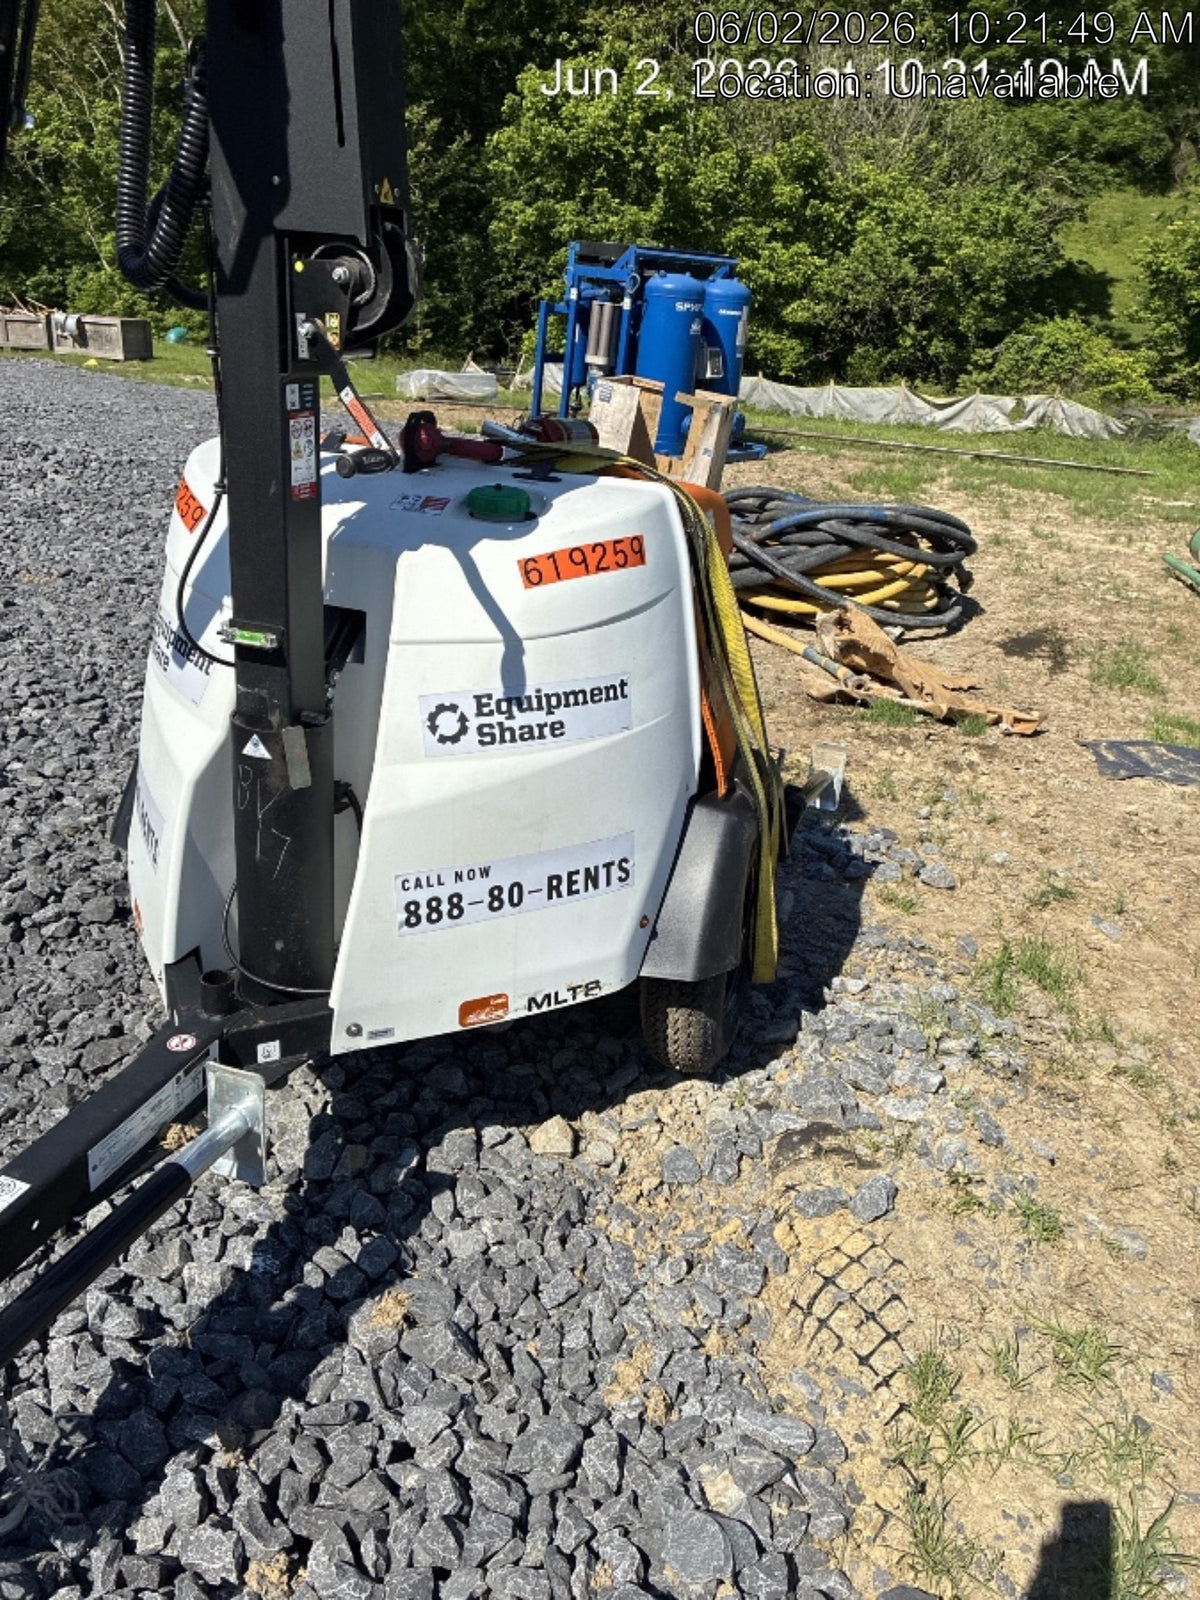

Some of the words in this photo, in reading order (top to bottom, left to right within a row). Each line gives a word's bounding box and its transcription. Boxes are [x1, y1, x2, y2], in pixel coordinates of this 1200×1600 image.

[523, 536, 645, 586] 619259
[472, 678, 629, 721] Equipment
[475, 719, 566, 747] Share
[401, 873, 445, 892] CALL
[454, 865, 492, 884] NOW
[403, 857, 631, 929] 888-80-RENTS
